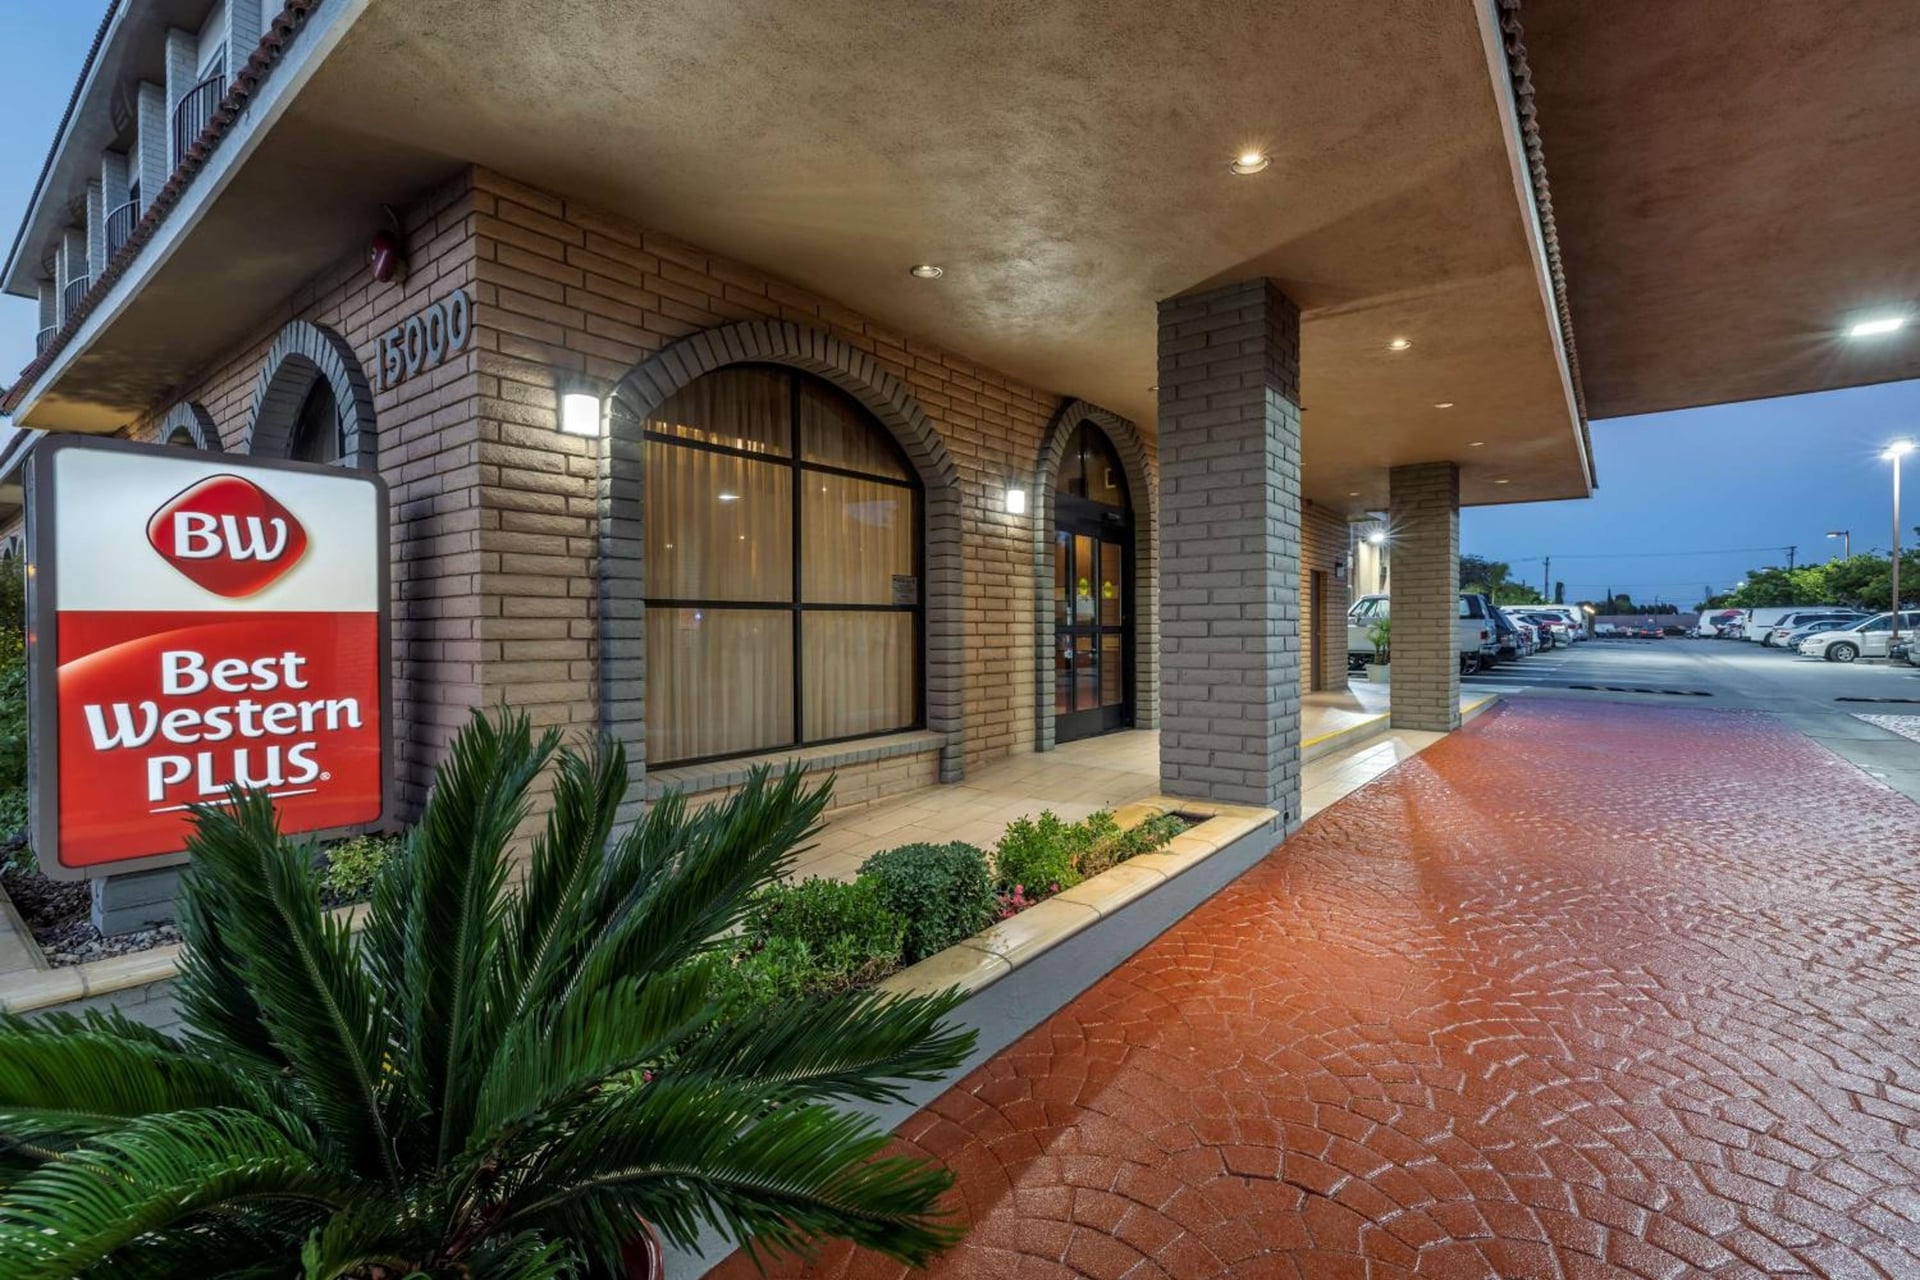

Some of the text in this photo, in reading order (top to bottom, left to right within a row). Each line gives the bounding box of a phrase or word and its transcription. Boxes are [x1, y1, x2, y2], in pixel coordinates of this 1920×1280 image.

[373, 288, 472, 391] 15000
[173, 511, 288, 561] BW
[161, 650, 308, 695] Best
[84, 696, 362, 750] Western
